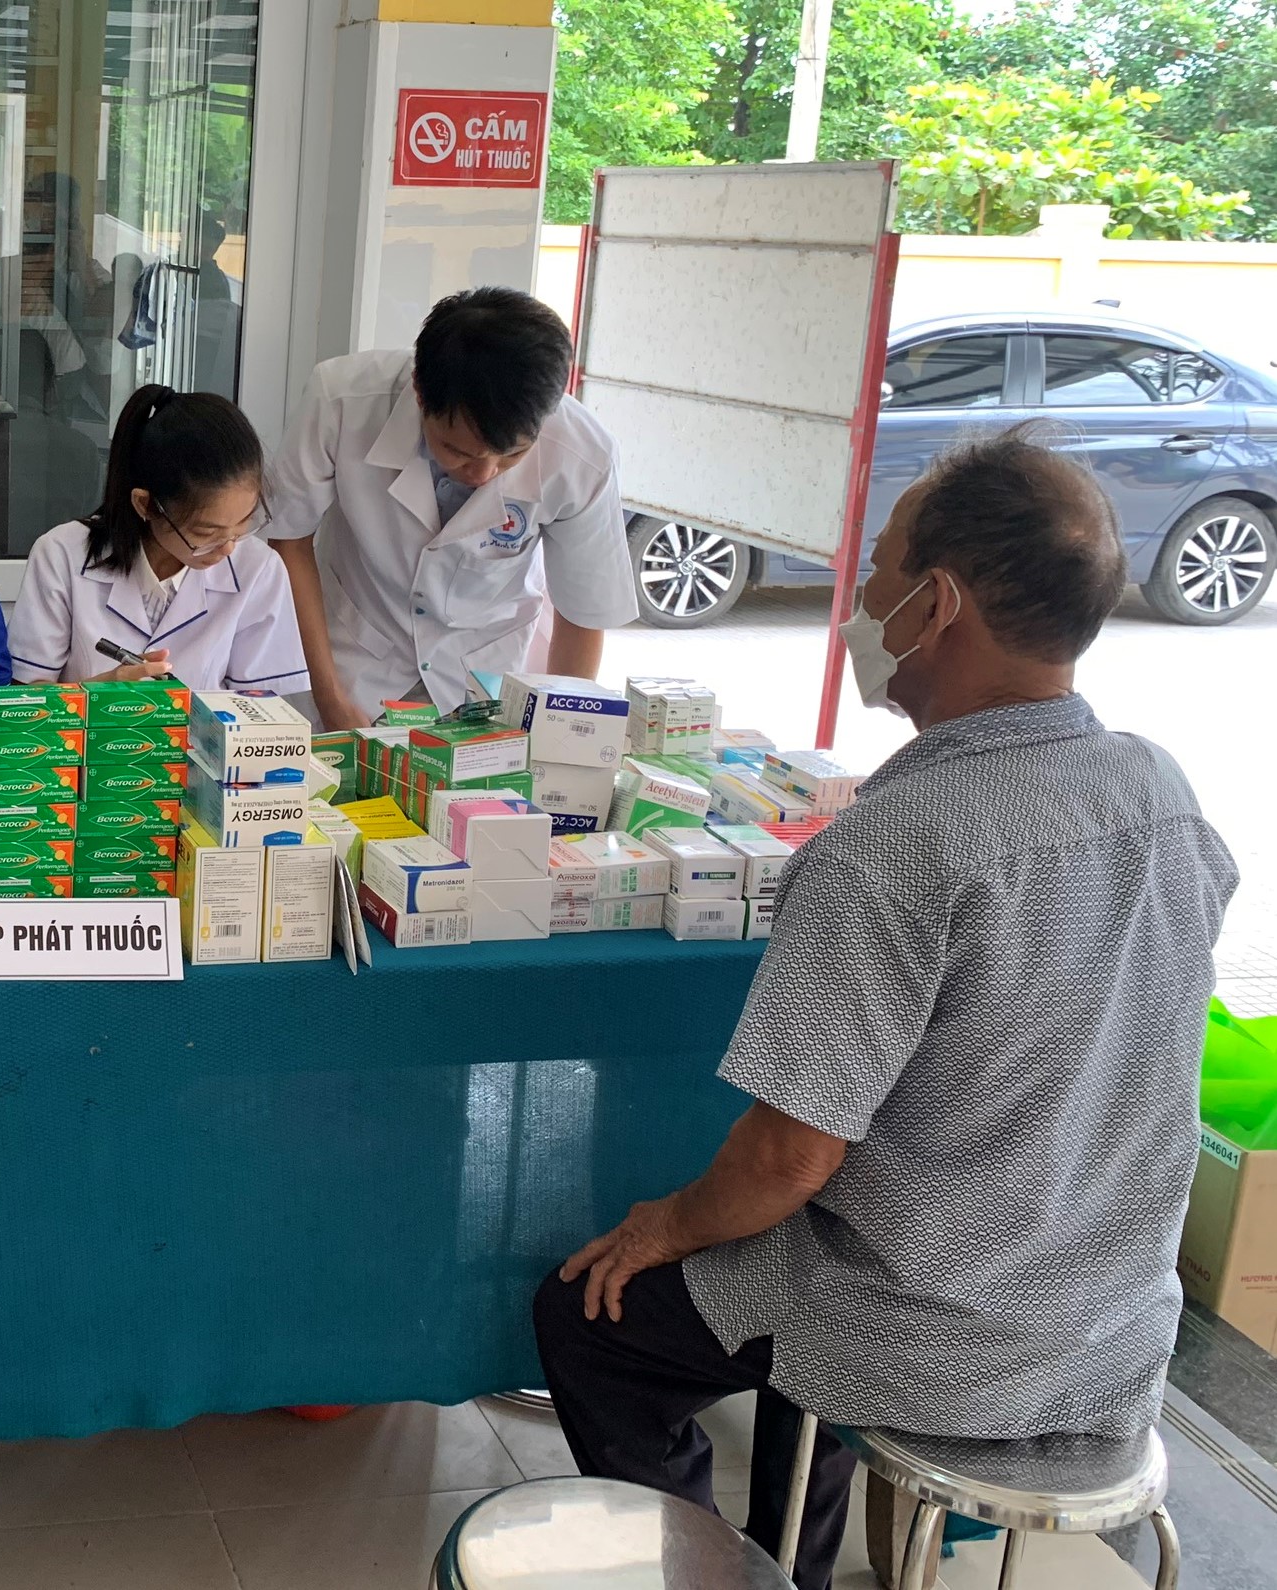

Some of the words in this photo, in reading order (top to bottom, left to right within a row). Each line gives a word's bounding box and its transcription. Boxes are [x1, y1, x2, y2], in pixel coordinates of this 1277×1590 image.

[465, 110, 527, 141] CẤM
[455, 145, 482, 168] HÚT
[487, 145, 531, 170] THUỐC
[108, 704, 145, 712] Berocca
[578, 700, 603, 711] 200
[1, 710, 39, 718] Berocca
[546, 714, 556, 722] 50
[0, 747, 38, 755] Berocca
[232, 744, 306, 758] OMSERGY
[412, 749, 447, 771] Paracetamol
[645, 780, 705, 808] Acetylcystein
[96, 815, 134, 823] Berocca
[231, 807, 303, 823] OMSERGY
[551, 816, 565, 825] 20
[556, 873, 596, 881] Ambroxol
[422, 878, 465, 887] Metronidazol
[13, 919, 74, 951] PHÁT
[82, 915, 163, 951] THUỐC
